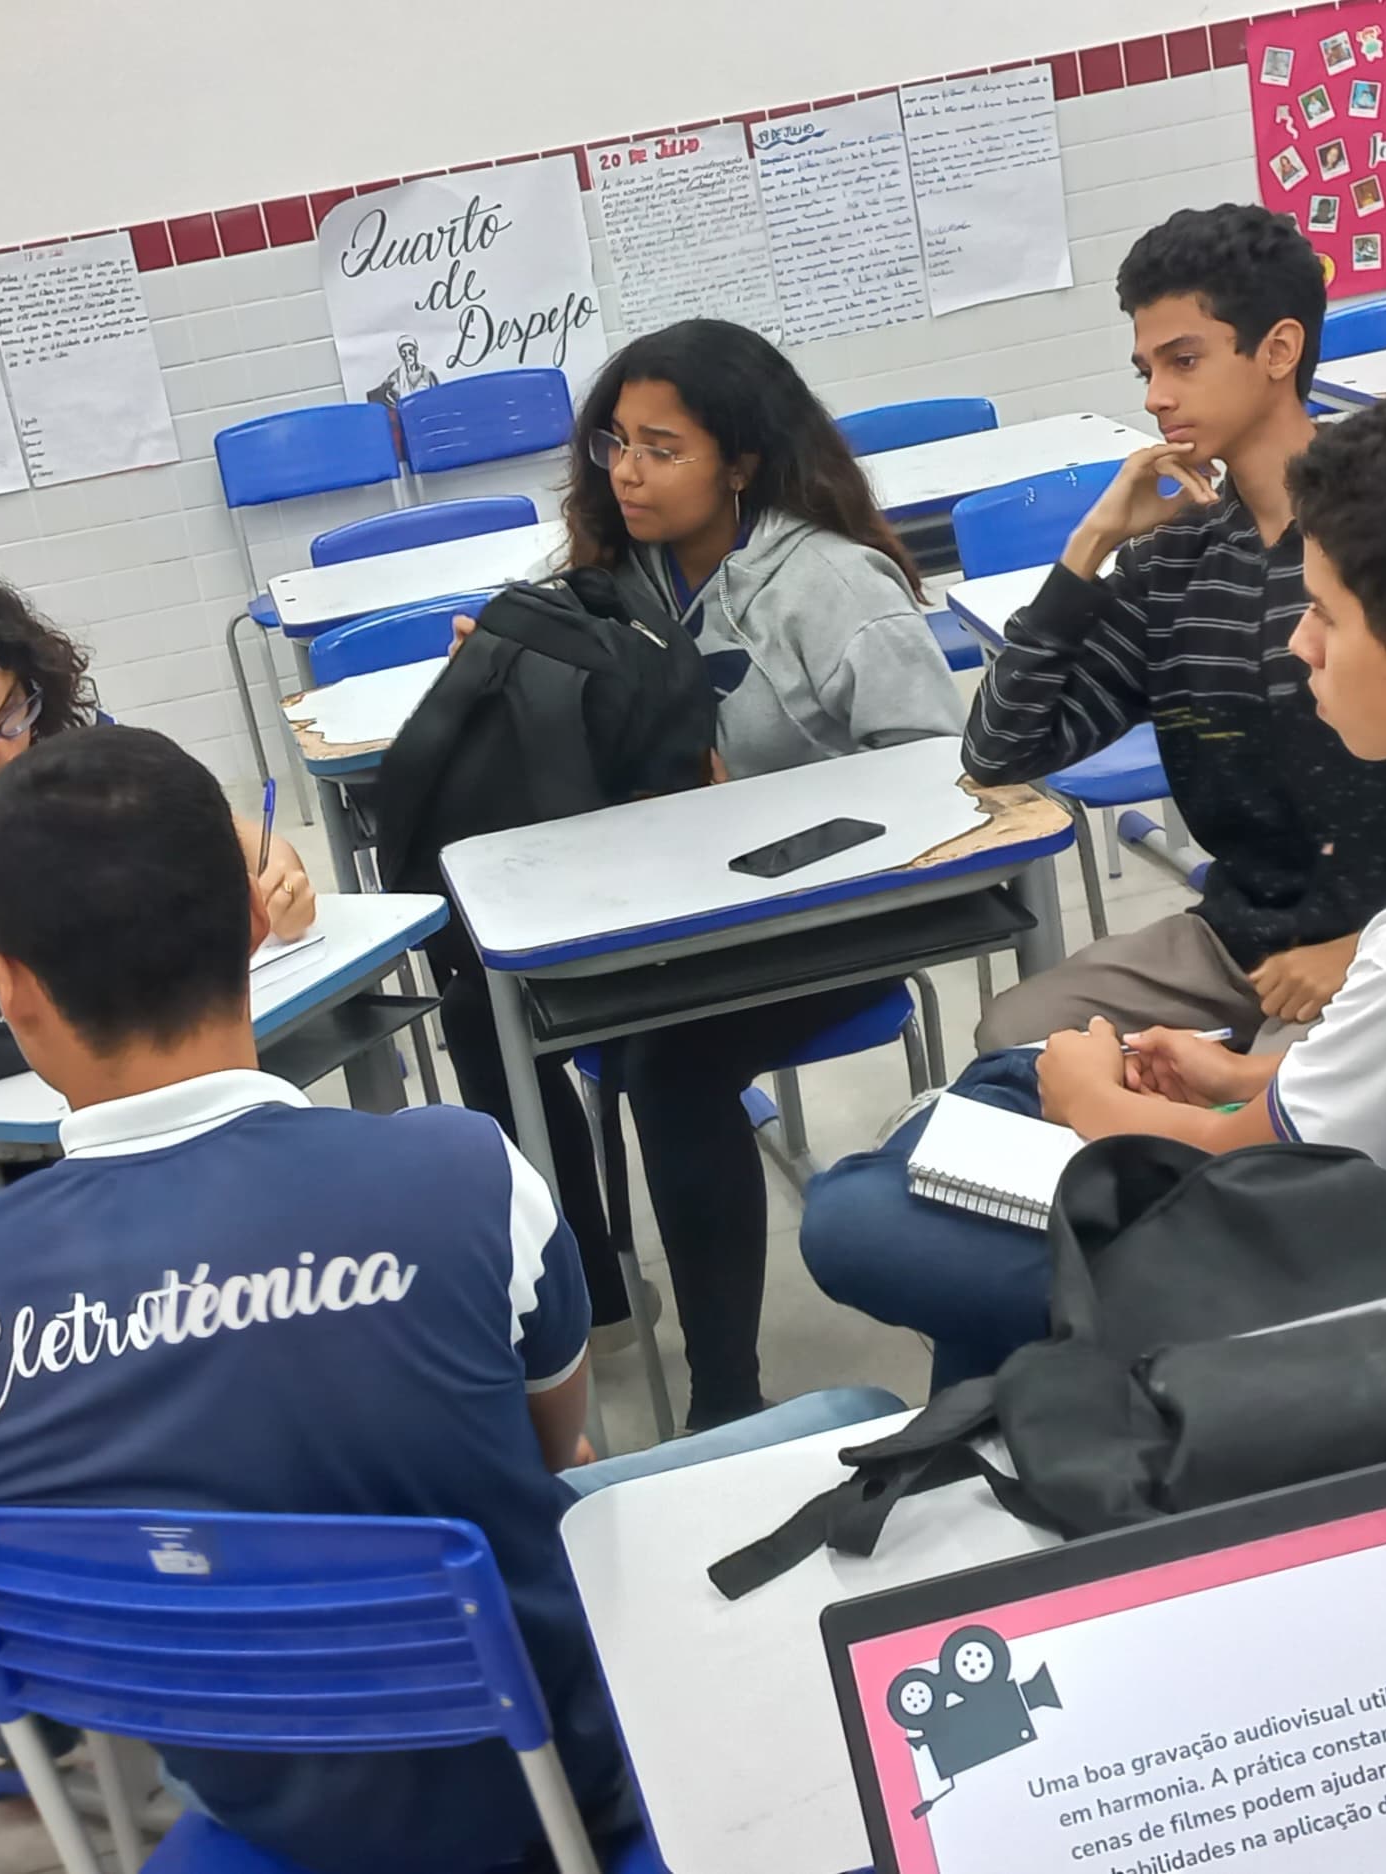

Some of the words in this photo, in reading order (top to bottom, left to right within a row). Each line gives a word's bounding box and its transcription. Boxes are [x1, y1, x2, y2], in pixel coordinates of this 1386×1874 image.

[599, 153, 621, 171] 20
[341, 195, 512, 278] Quarto
[414, 259, 486, 310] de
[446, 292, 599, 368] Despejo
[1027, 1774, 1079, 1798] Uma
[1083, 1762, 1125, 1783] boa
[1130, 1731, 1227, 1776] gravação
[1233, 1696, 1355, 1744] audiovisual
[1059, 1807, 1092, 1827] em
[1096, 1776, 1205, 1817] harmonia.
[1211, 1767, 1228, 1787] A
[1232, 1750, 1306, 1786] prática
[1071, 1832, 1132, 1859] cenas
[1138, 1821, 1165, 1842] de
[1169, 1804, 1236, 1834] filmes
[1241, 1783, 1315, 1819] podem
[1320, 1764, 1386, 1796] ajudar
[1240, 1833, 1267, 1851] na
[1272, 1802, 1372, 1844] aplicação
